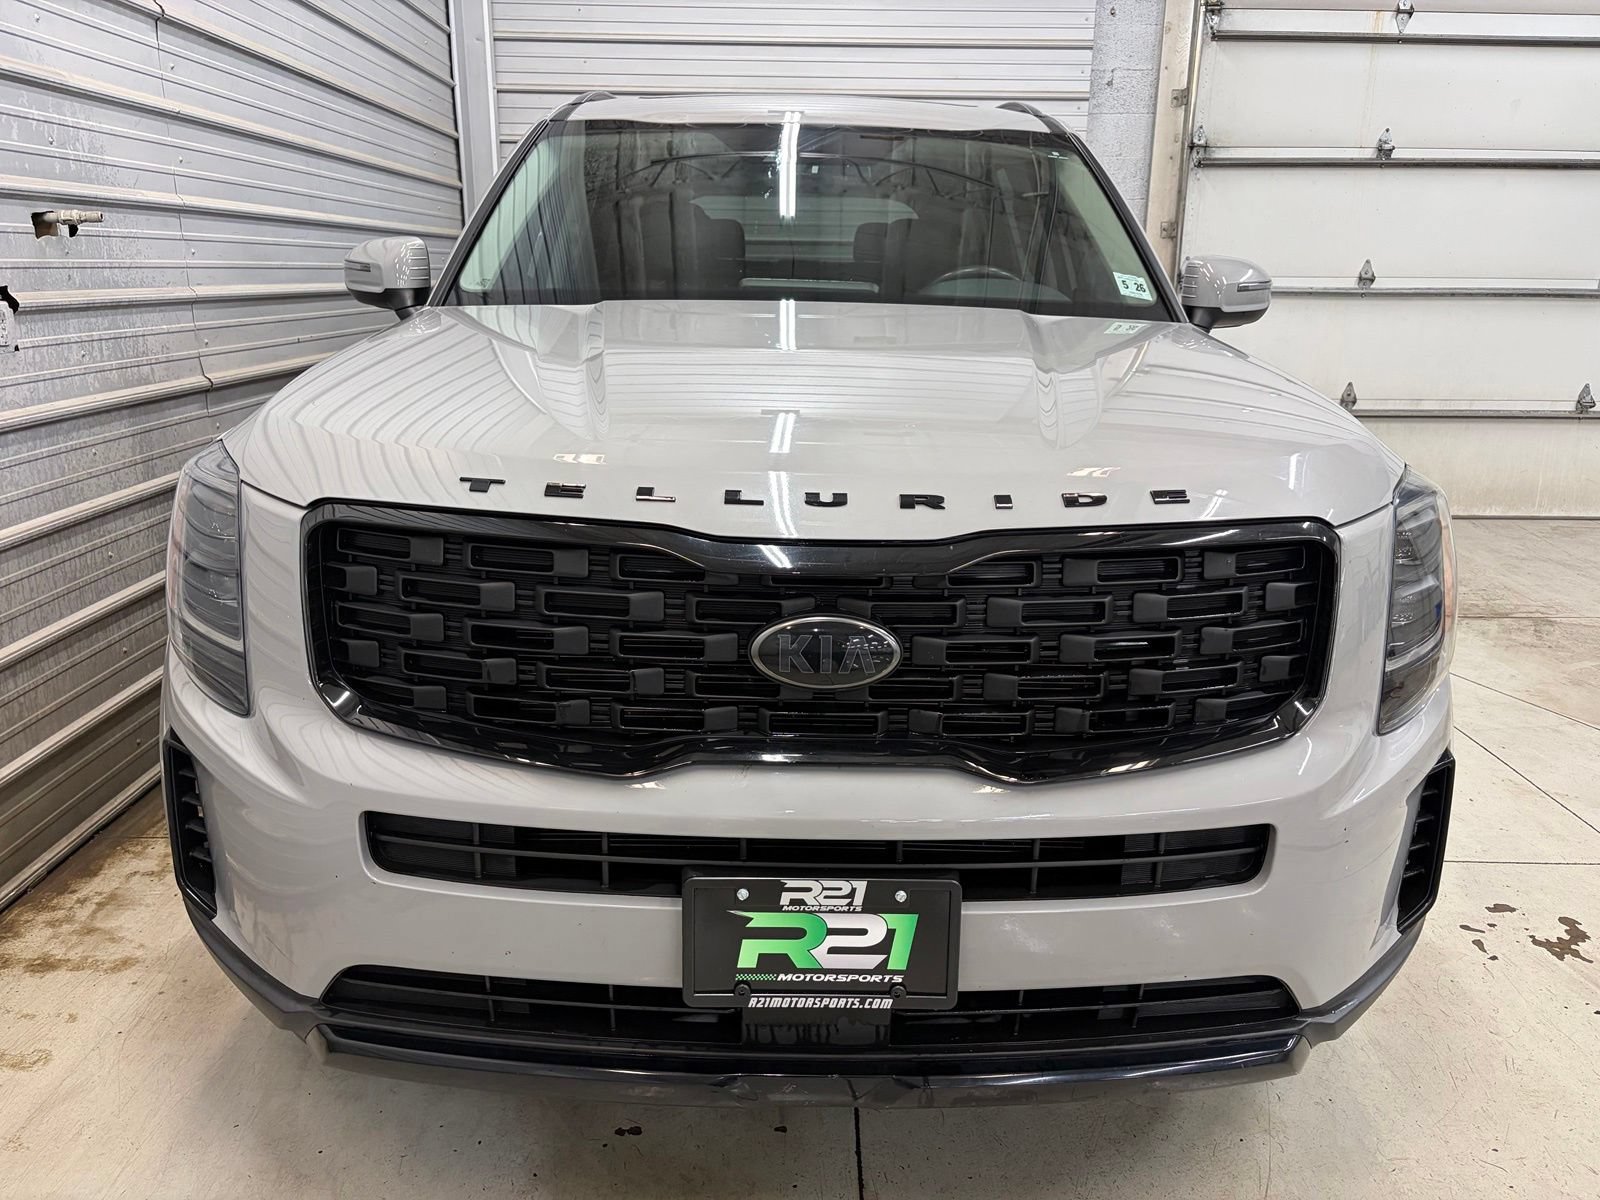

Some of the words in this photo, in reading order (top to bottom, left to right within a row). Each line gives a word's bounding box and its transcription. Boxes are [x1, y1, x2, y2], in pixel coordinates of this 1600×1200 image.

[1121, 280, 1129, 289] 5
[1133, 282, 1146, 293] 26
[459, 476, 1191, 509] TELLURIDE
[777, 634, 876, 674] KIA
[780, 880, 868, 905] R21
[728, 911, 919, 969] R21
[777, 973, 905, 983] MOTORSPORTS
[748, 997, 893, 1009] R21MOTORSPORTS.COM
